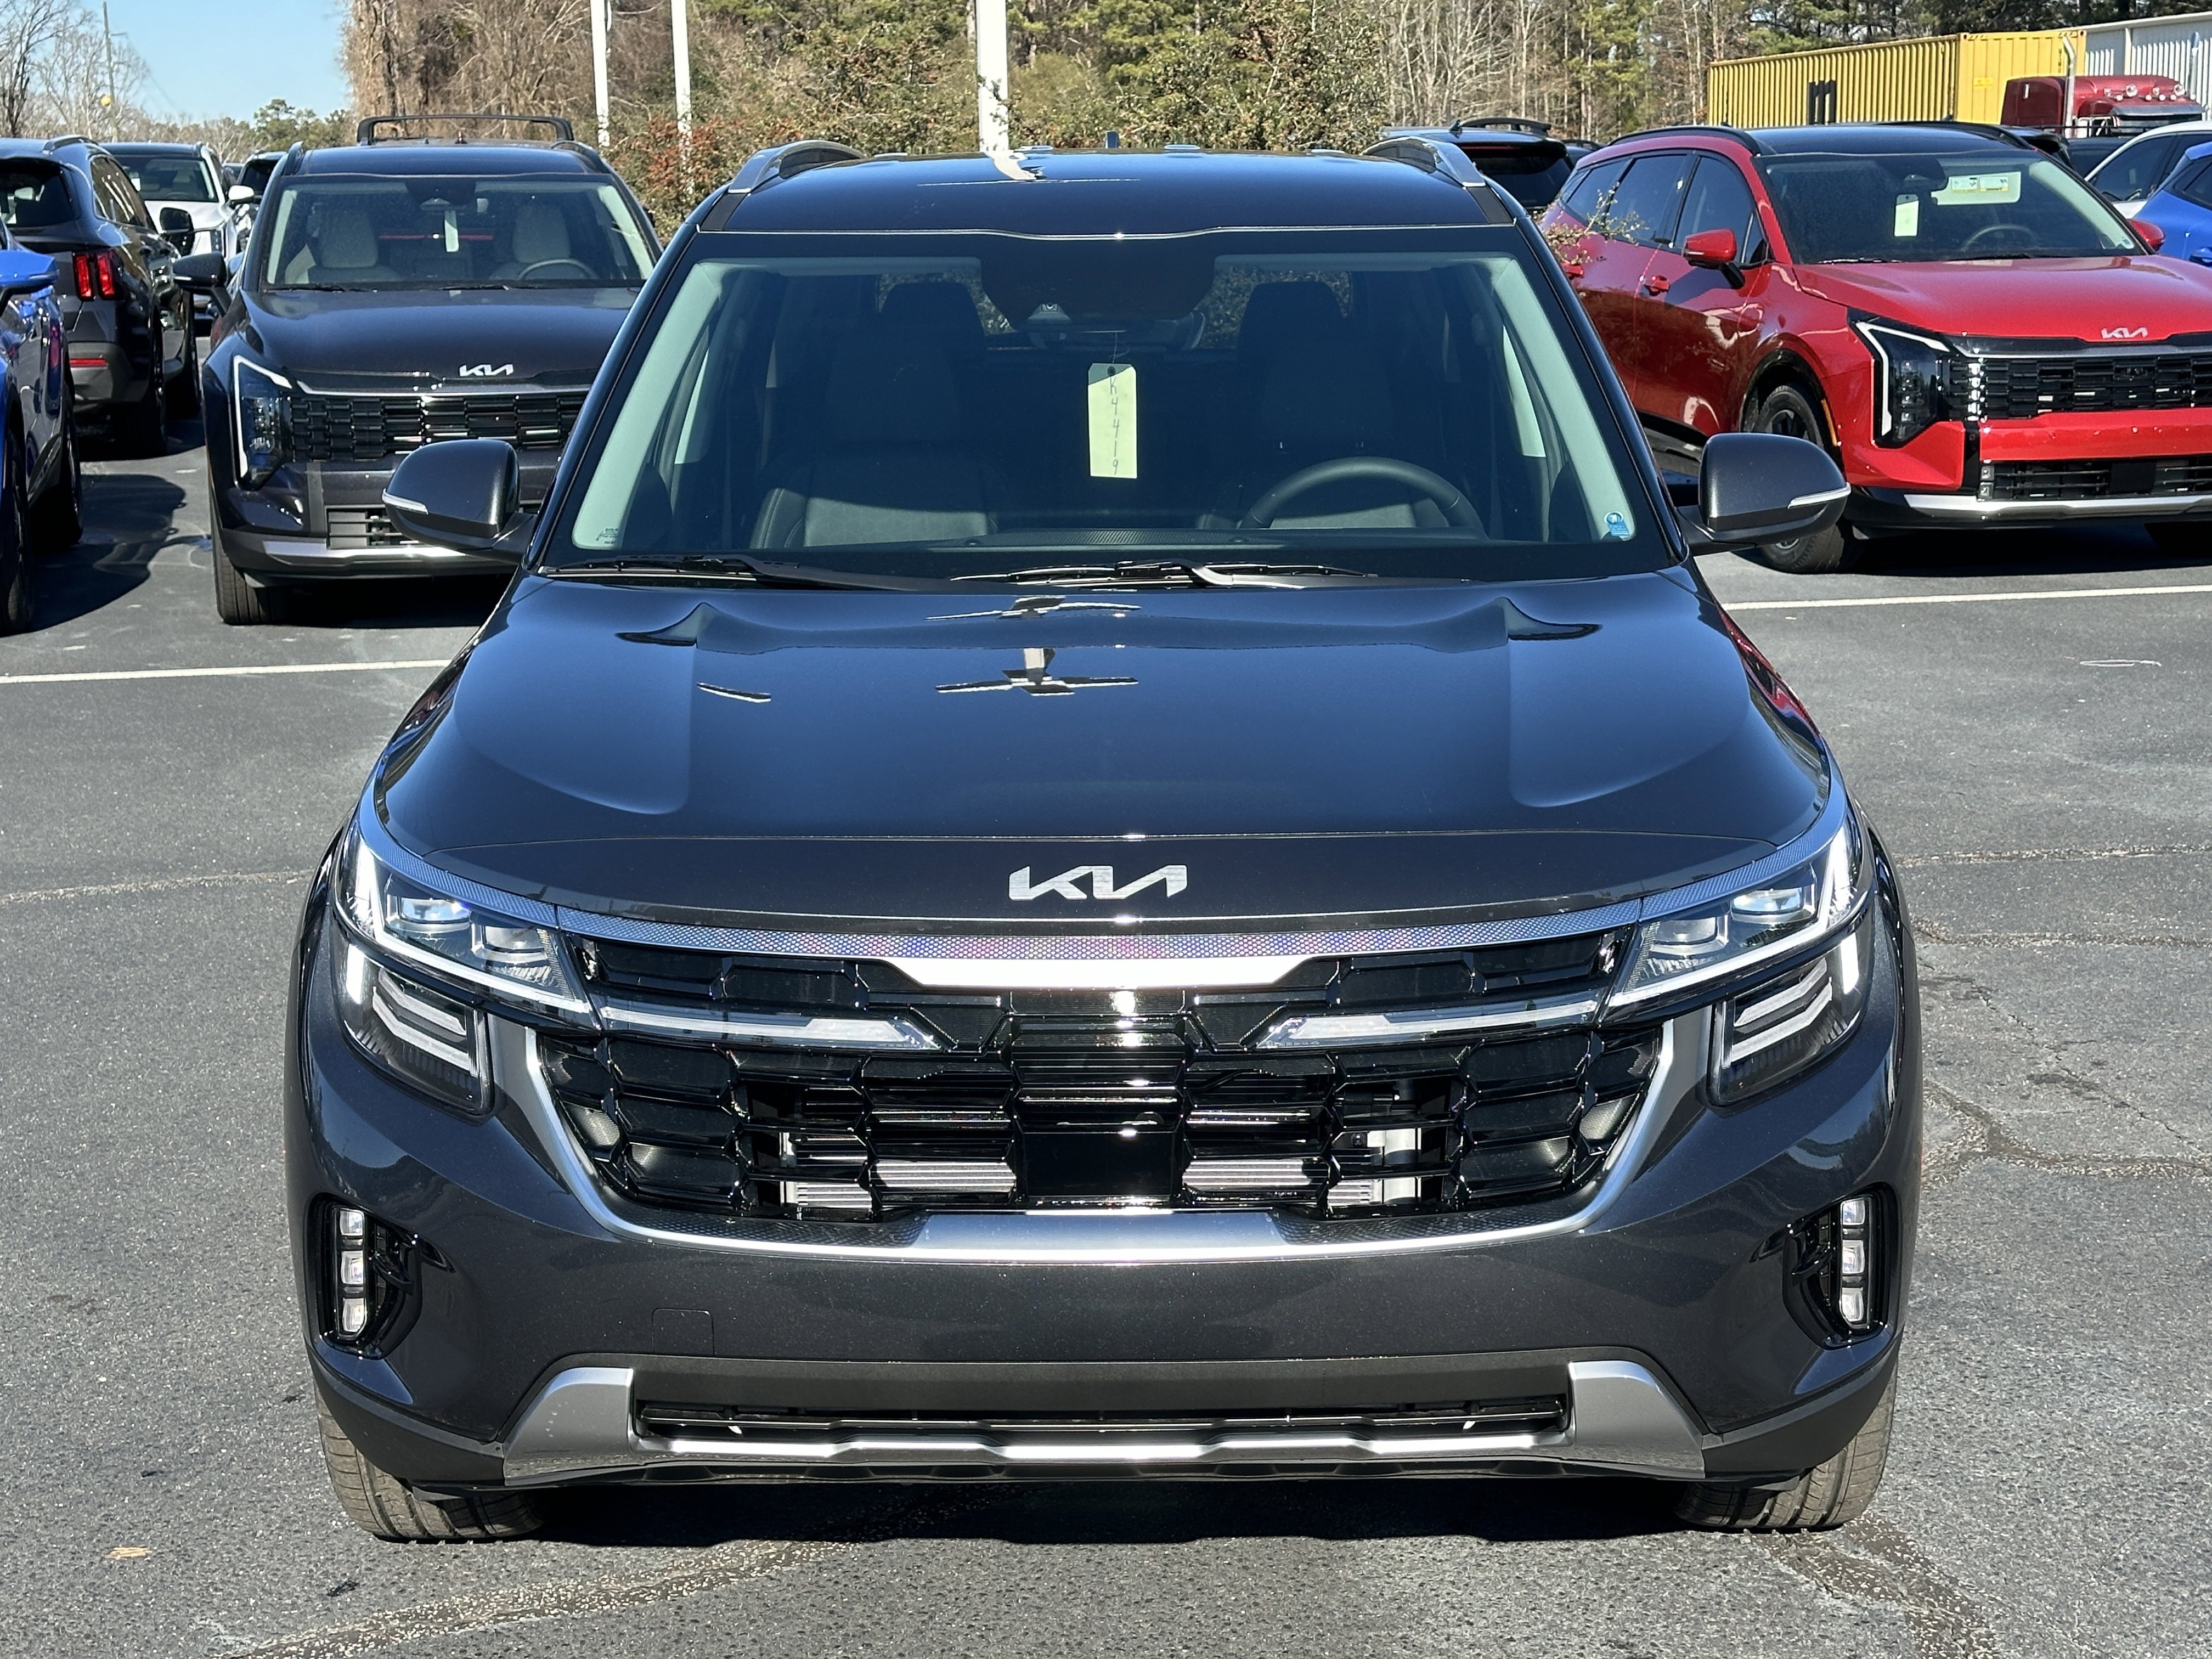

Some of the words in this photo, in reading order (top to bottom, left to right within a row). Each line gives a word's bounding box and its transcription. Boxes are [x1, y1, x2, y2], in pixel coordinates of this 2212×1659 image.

[2101, 328, 2148, 339] KIA
[459, 364, 514, 377] KIA
[1009, 865, 1187, 900] KIA
